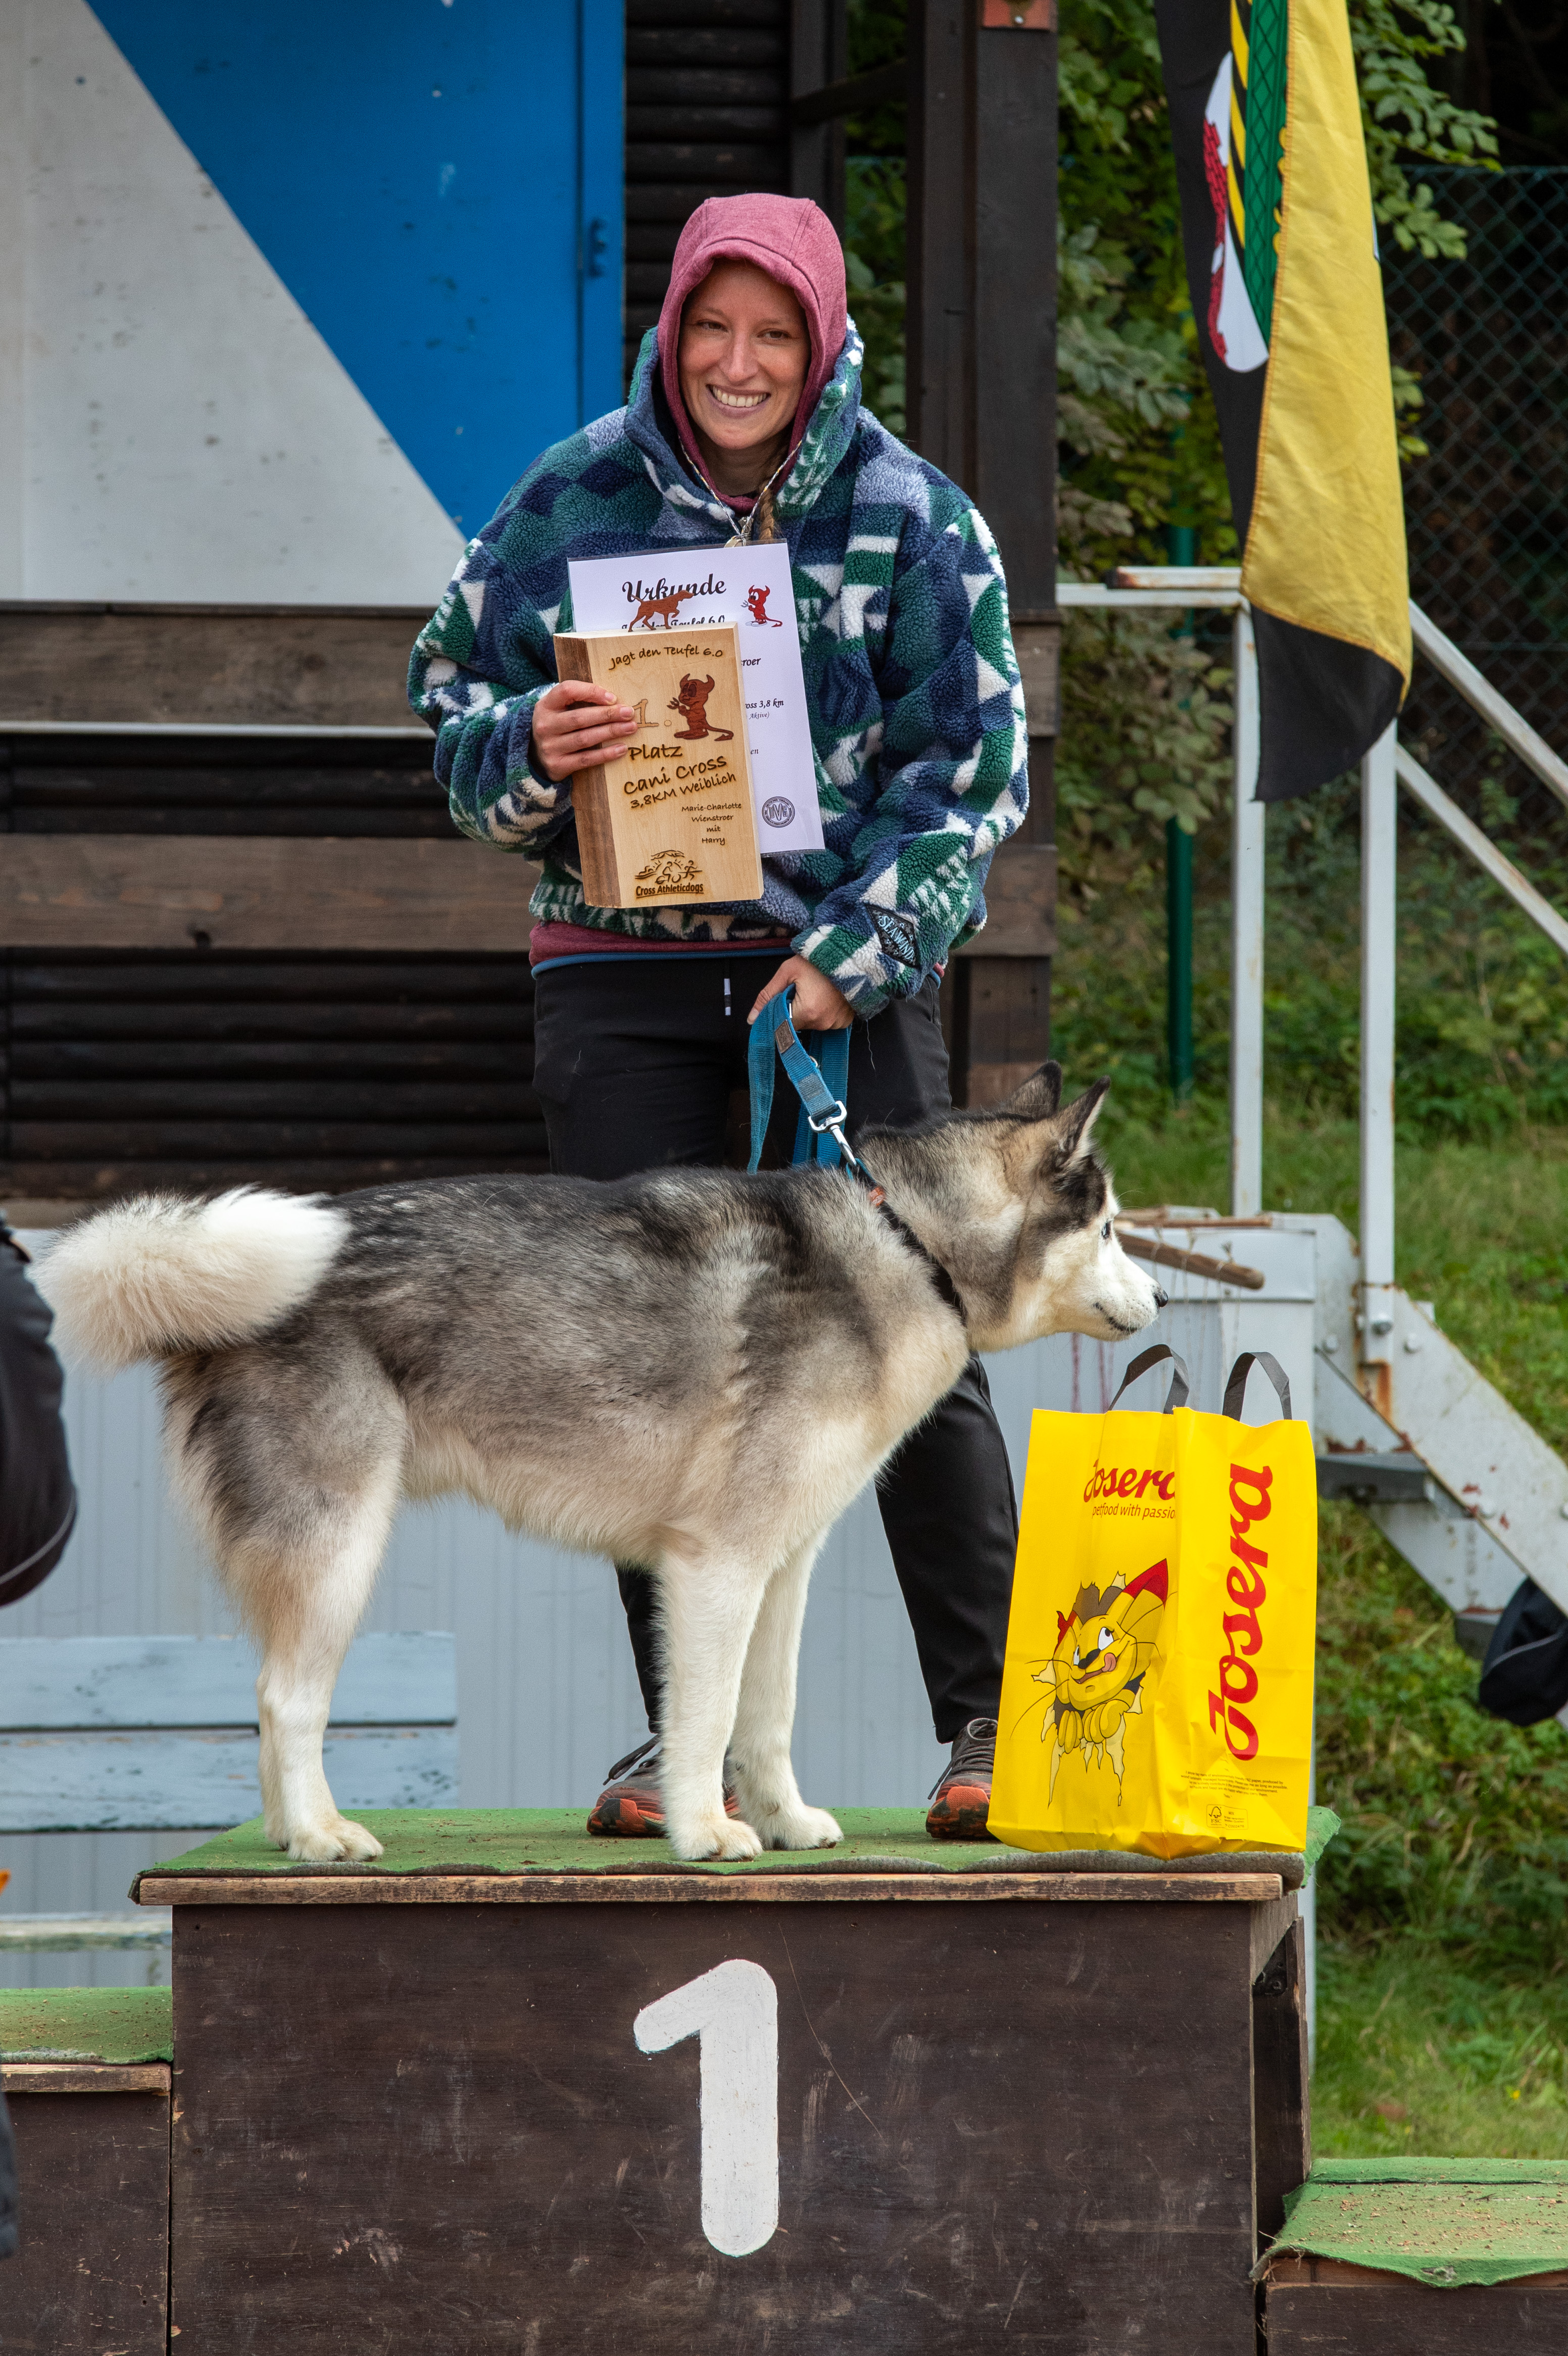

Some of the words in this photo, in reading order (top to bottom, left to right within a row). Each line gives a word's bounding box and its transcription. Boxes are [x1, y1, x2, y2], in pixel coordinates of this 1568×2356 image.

[608, 652, 635, 670] Jagt
[639, 648, 661, 658] den
[663, 644, 699, 658] Teufel
[703, 648, 723, 657] 6.0
[741, 658, 761, 666] roer
[759, 700, 770, 709] 3,8
[773, 698, 784, 708] km
[627, 744, 682, 760] Platz
[624, 766, 670, 795] Cani
[676, 756, 727, 779] Cross
[630, 788, 677, 808] 3,8KM
[679, 772, 737, 795] Weiblich
[681, 803, 742, 812] Marie-Charlotte
[768, 803, 788, 821] DVG
[706, 824, 721, 832] mit
[702, 838, 725, 846] Harry
[635, 886, 656, 896] Cross
[657, 882, 704, 894] Athleticdogs
[1092, 1502, 1119, 1519] petfood
[1120, 1504, 1141, 1516] with
[1142, 1506, 1176, 1520] passio
[1208, 1463, 1272, 1760] Josera
[633, 1959, 778, 2257] 1
